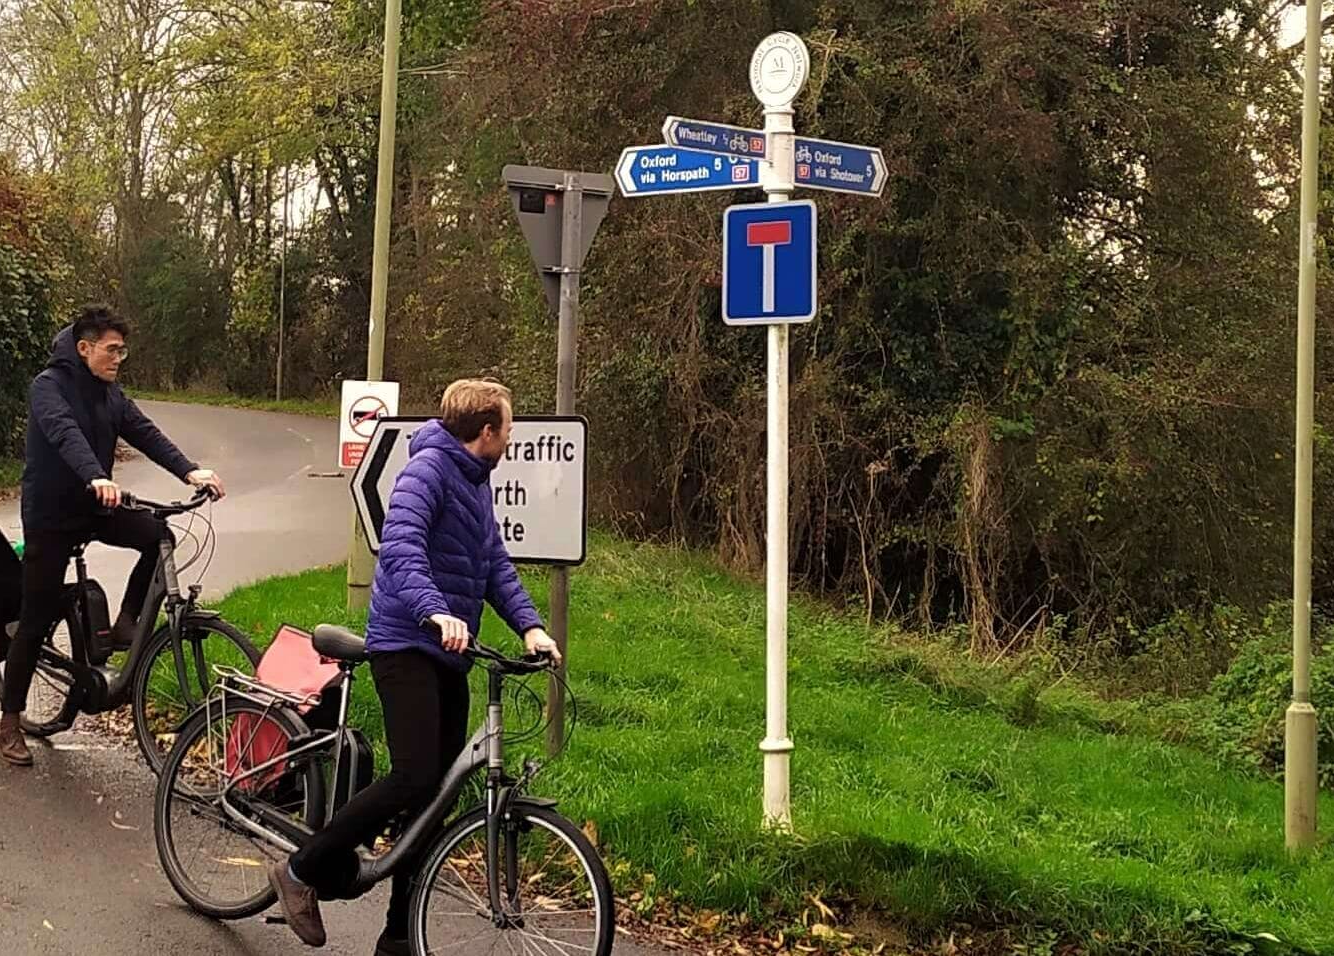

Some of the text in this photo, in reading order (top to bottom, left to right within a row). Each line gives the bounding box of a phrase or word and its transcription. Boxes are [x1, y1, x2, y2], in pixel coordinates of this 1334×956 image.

[679, 127, 717, 145] Wheatley
[752, 140, 762, 150] 57
[640, 154, 677, 169] Oxford
[714, 157, 722, 171] 5
[814, 150, 842, 166] Oxford
[641, 167, 710, 184] via Horspath
[735, 169, 747, 179] 57
[815, 166, 864, 183] via Shotover
[505, 435, 575, 462] traffic
[494, 480, 527, 506] rth
[496, 516, 525, 542] te
